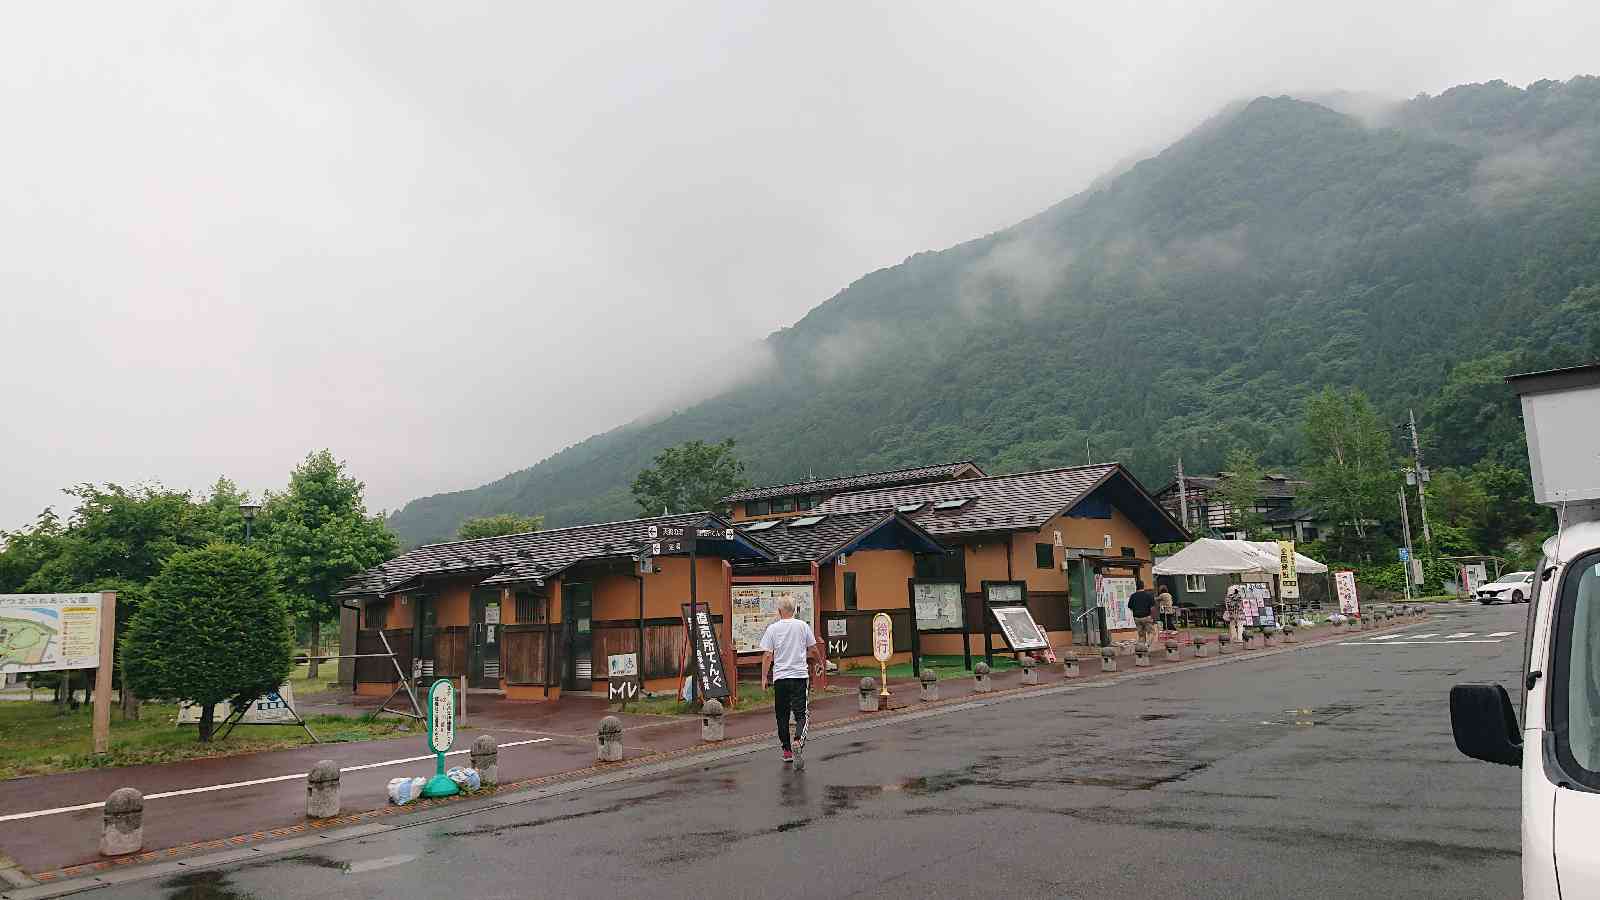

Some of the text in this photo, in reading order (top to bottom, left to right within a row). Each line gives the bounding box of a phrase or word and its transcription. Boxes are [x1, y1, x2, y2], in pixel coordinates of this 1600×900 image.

[696, 612, 722, 688] 直売所てんぐ
[828, 639, 848, 655] トイレ
[876, 622, 889, 654] 徐行
[609, 681, 637, 700] トイレ
